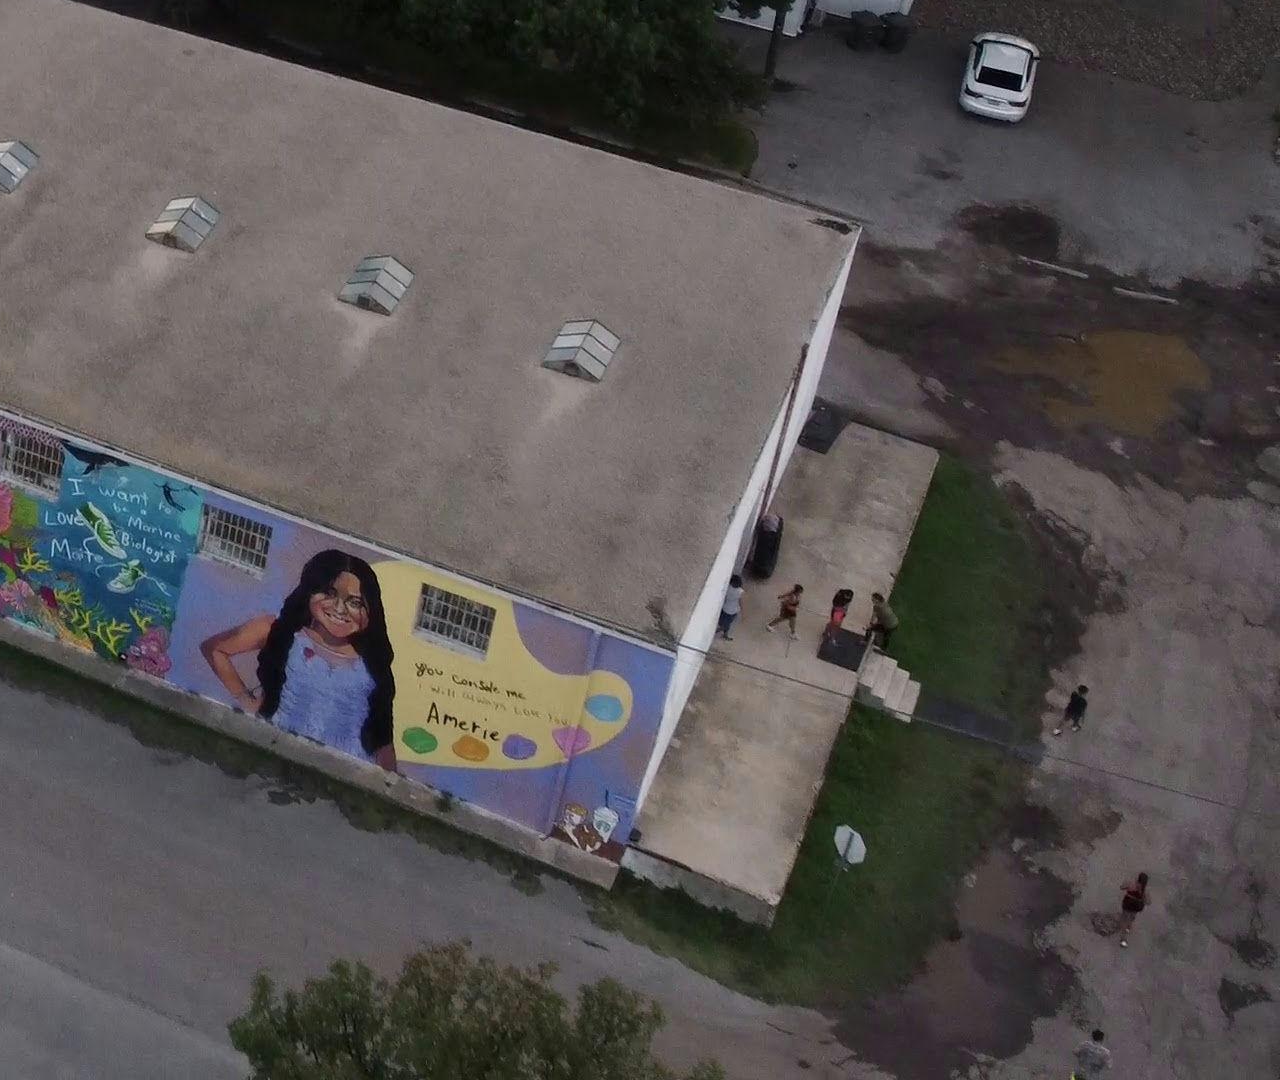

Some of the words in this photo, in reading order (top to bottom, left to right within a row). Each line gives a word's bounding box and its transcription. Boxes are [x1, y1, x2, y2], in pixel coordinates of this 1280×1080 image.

[68, 478, 85, 496] I
[98, 486, 149, 506] want
[127, 516, 182, 543] Marine
[51, 538, 104, 564] Maite
[121, 532, 177, 563] Biologist
[506, 689, 527, 700] me
[426, 701, 501, 742] Amerie
